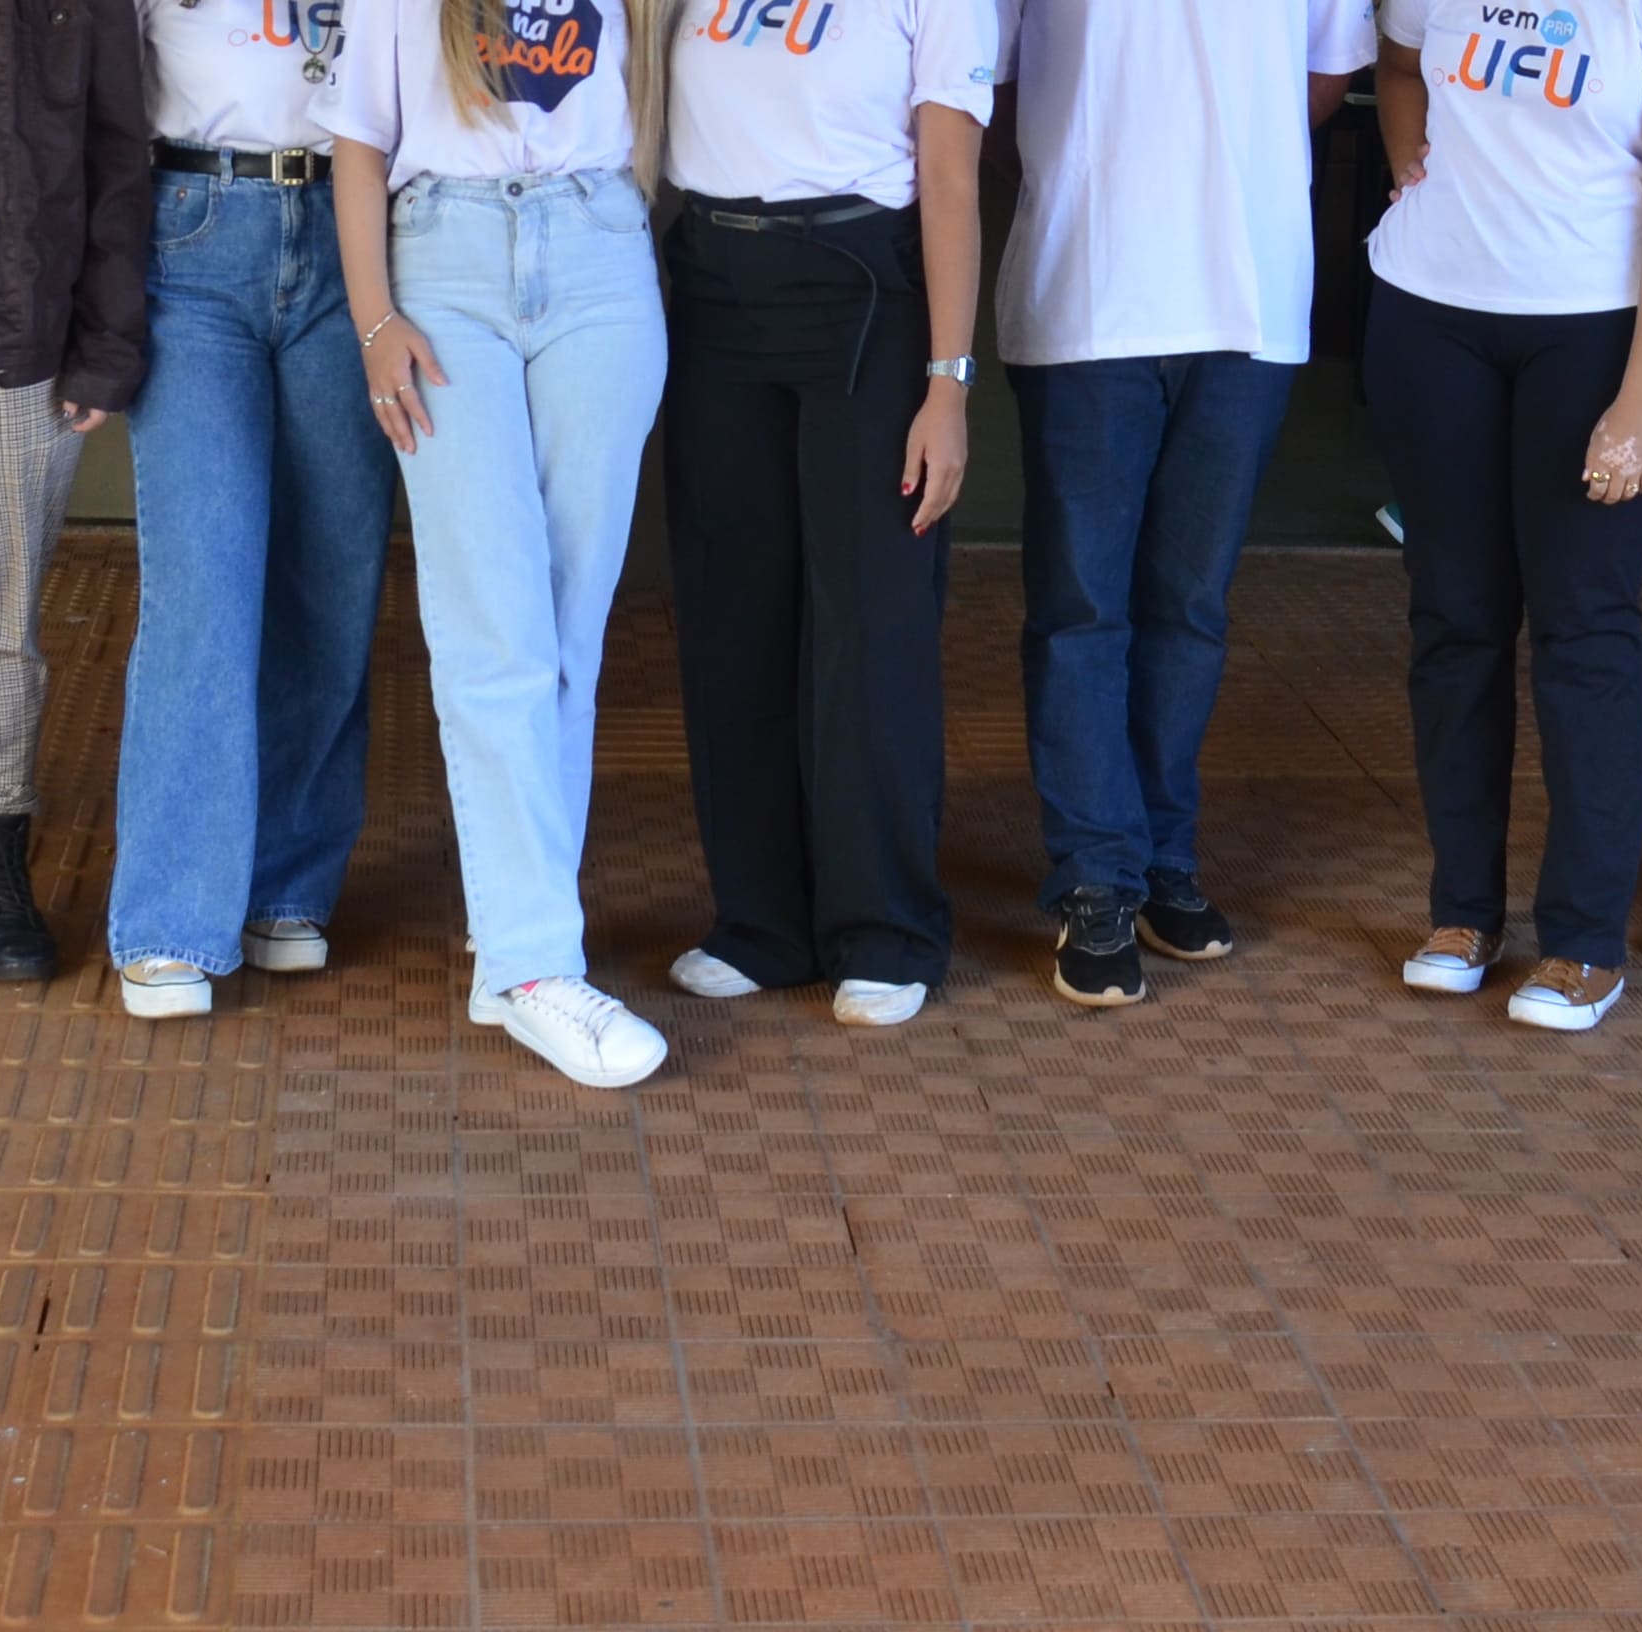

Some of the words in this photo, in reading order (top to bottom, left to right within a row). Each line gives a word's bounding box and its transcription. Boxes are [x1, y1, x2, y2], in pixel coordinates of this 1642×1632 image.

[513, 12, 550, 42] na
[1481, 5, 1539, 30] vem
[1544, 19, 1573, 37] PRA
[1458, 33, 1590, 108] UFU
